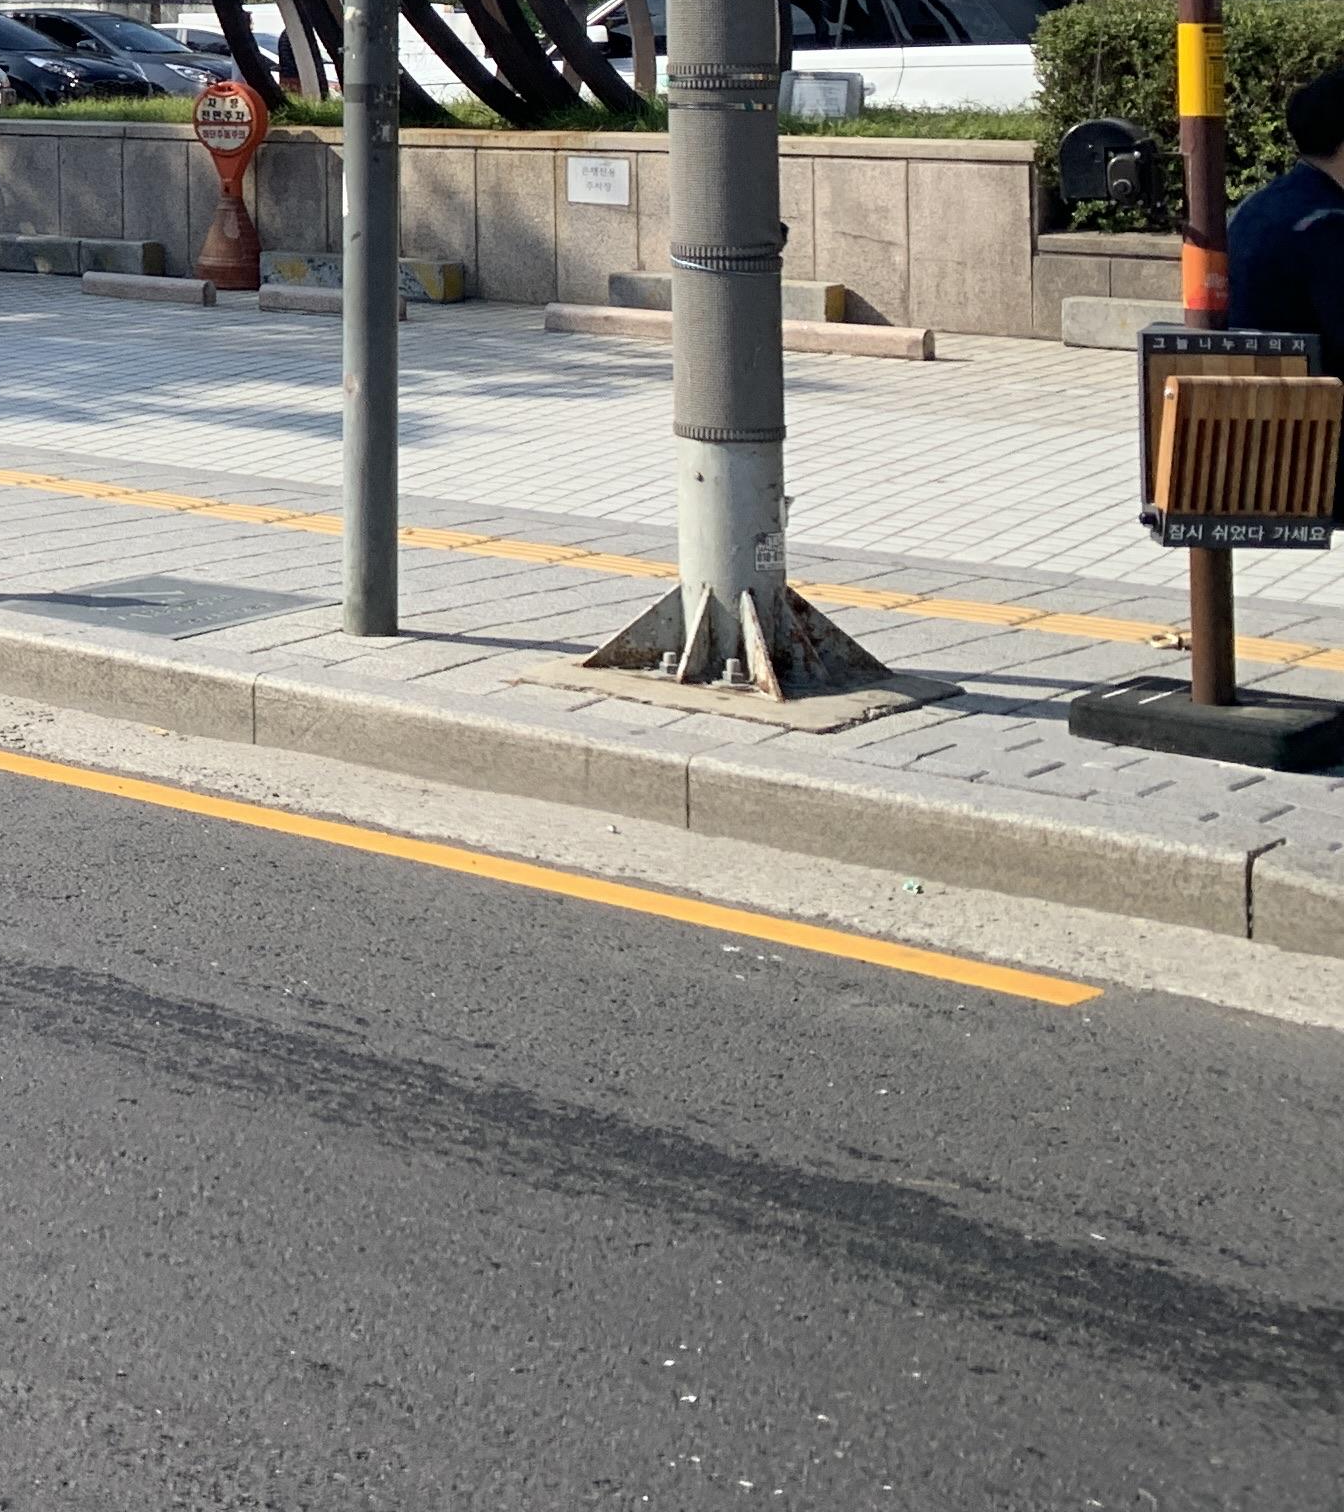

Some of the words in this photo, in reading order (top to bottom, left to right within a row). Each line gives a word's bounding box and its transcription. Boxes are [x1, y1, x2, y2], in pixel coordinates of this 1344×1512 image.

[1168, 523, 1203, 541] 잠시
[1212, 524, 1264, 541] 쉬었다
[1274, 525, 1326, 542] 가세요
